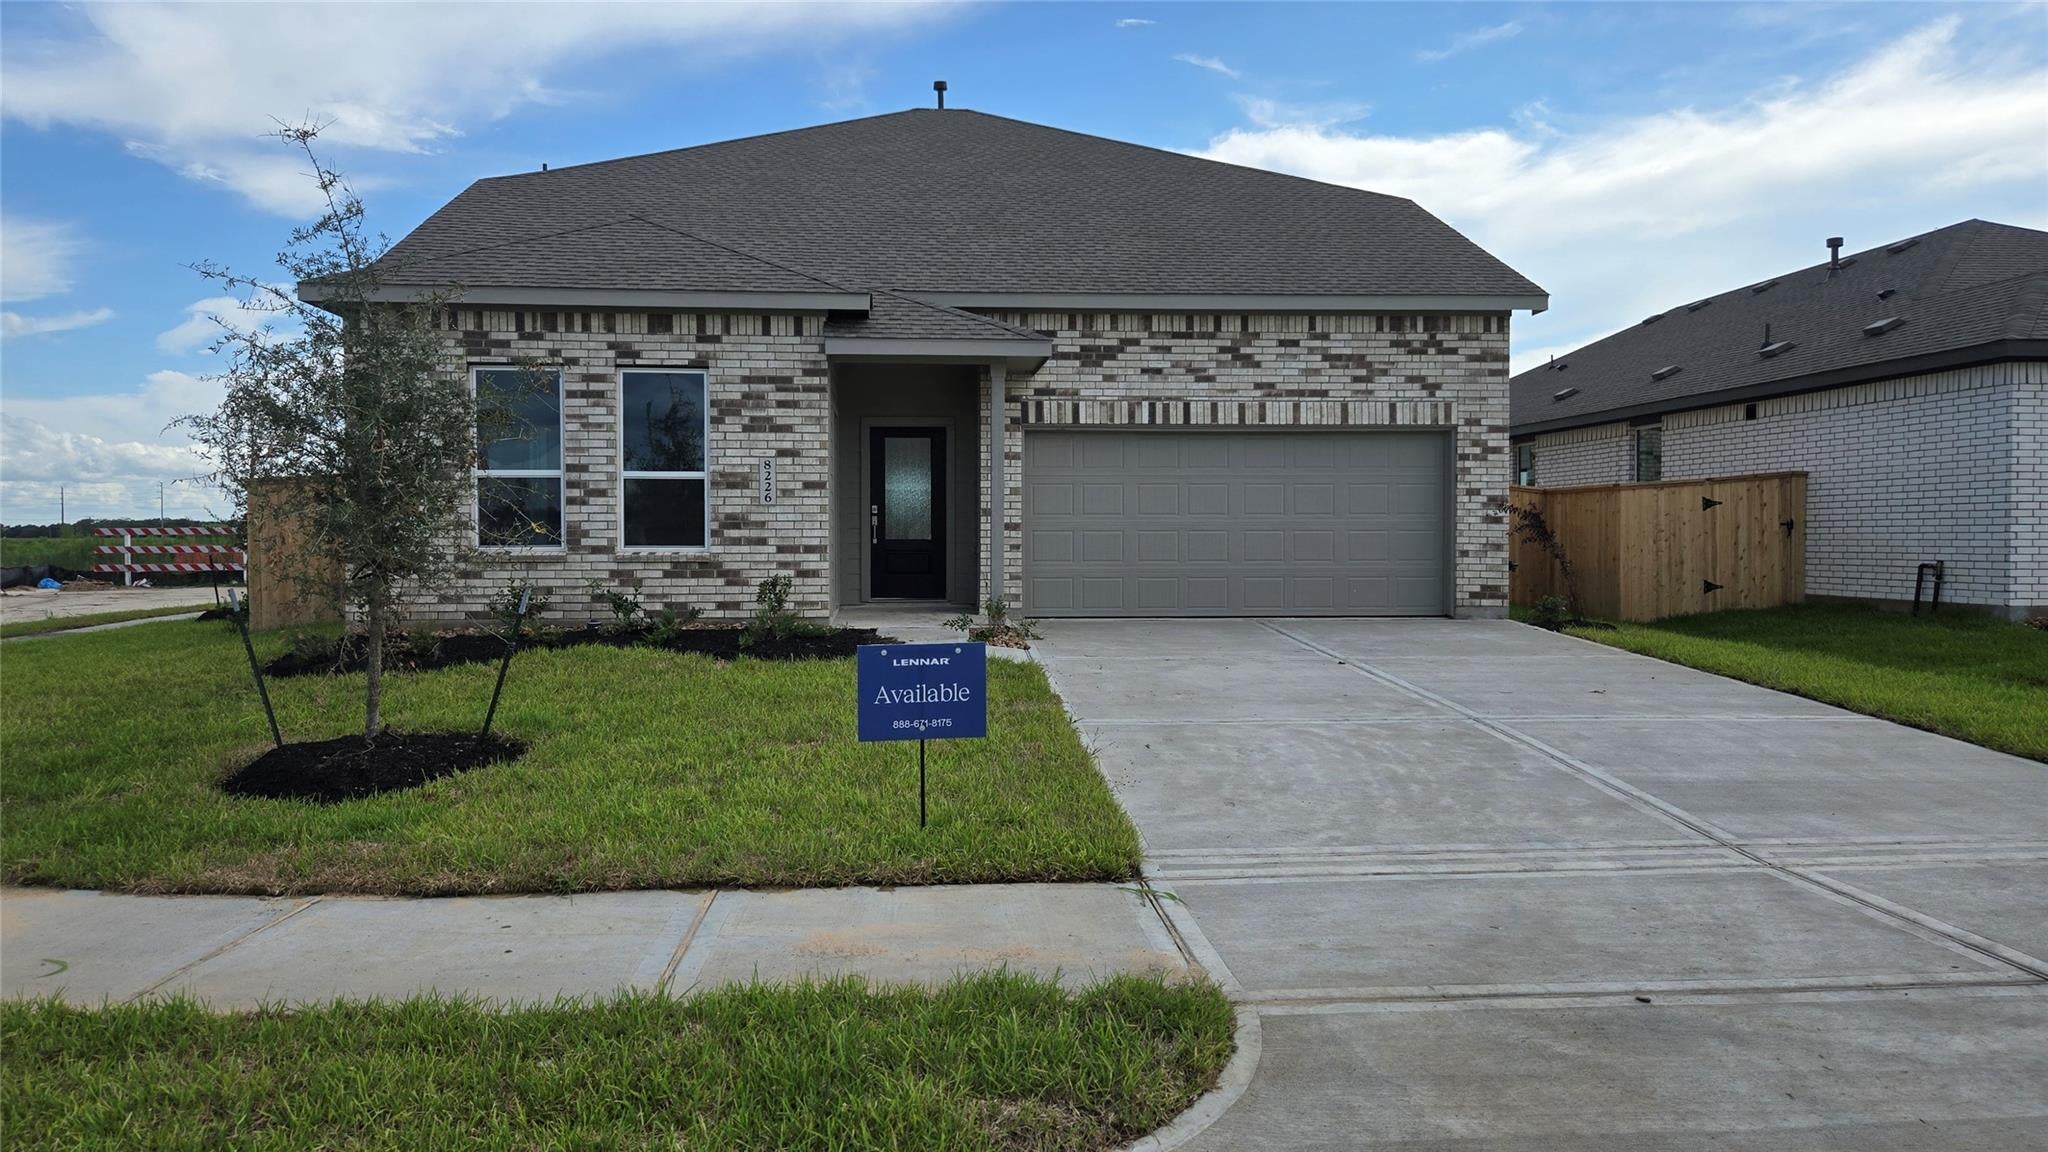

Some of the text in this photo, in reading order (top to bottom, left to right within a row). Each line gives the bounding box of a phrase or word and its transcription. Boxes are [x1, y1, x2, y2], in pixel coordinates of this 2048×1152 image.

[764, 460, 772, 503] 8226
[893, 658, 949, 667] LENNAR
[873, 683, 970, 704] Available
[892, 719, 952, 729] 888-671-8175
